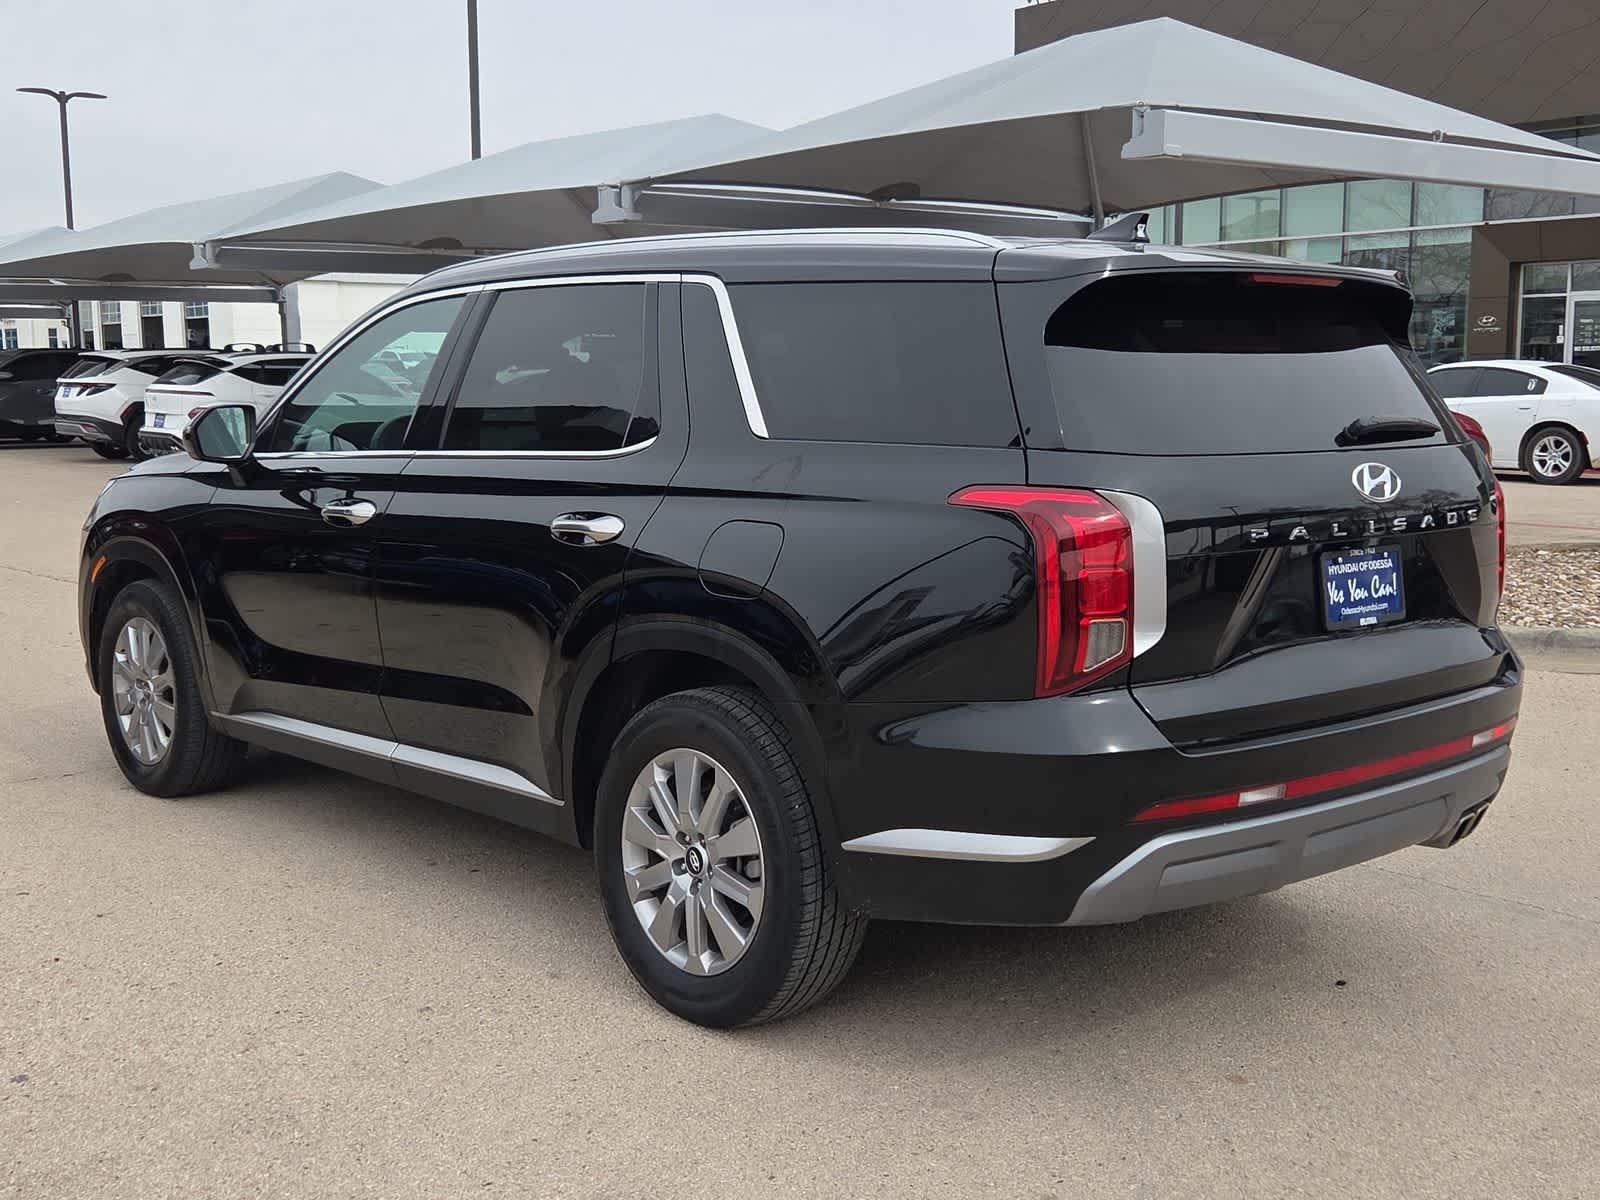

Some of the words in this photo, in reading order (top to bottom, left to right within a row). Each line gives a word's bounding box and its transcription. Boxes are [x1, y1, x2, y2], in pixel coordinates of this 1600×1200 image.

[1250, 508, 1480, 543] PALISADE
[1328, 562, 1359, 576] HYUNDAI
[1359, 561, 1369, 572] OF
[1368, 558, 1393, 570] ODESSA
[1327, 580, 1345, 605] Yes
[1347, 577, 1369, 602] You
[1371, 572, 1397, 599] Can!
